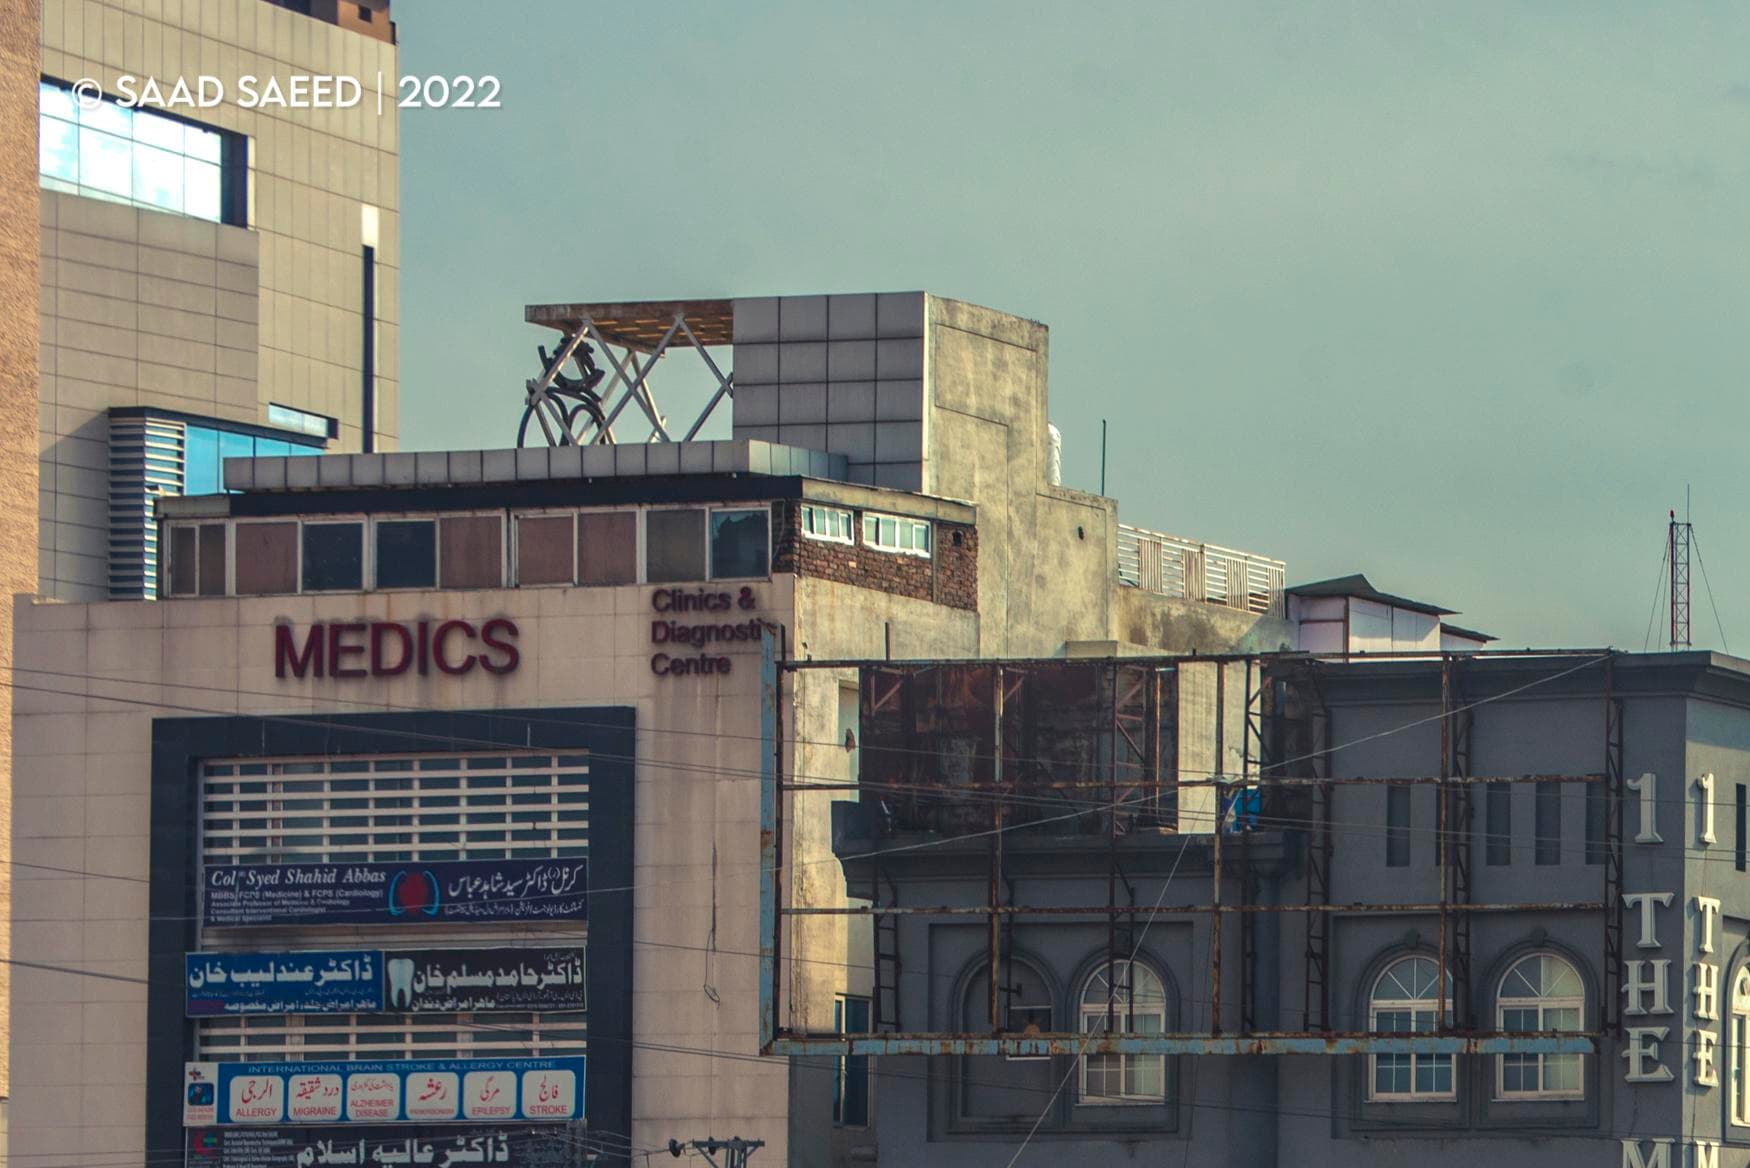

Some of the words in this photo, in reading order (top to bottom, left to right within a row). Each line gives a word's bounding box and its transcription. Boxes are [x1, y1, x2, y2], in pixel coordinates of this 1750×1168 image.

[652, 587, 731, 611] Clinics
[738, 587, 756, 609] &
[652, 618, 763, 648] Diagnosti
[274, 619, 519, 678] MEDICS
[651, 653, 731, 675] Centre
[1627, 773, 1662, 843] 1
[1698, 773, 1717, 845] 1
[211, 870, 236, 887] Col
[247, 869, 281, 891] Syed
[285, 868, 337, 885] Shahid
[343, 868, 387, 883] Abbas
[448, 875, 480, 899] عباس
[312, 890, 334, 898] FCPS
[189, 961, 227, 989] خان
[314, 953, 373, 987] ڈاکٹر
[413, 963, 446, 993] خان
[446, 963, 496, 994] مسلم
[495, 961, 538, 987] حامد
[537, 957, 583, 990] ڈاکٹر
[1622, 892, 1675, 1083] THE
[248, 1064, 341, 1074] INTERNATIONAL
[346, 1063, 383, 1072] BRAIN
[386, 1062, 435, 1071] STROKE
[438, 1062, 446, 1070] &
[449, 1060, 502, 1071] ALLERGY
[507, 1060, 556, 1069] CENTRE
[241, 1078, 272, 1104] الرجی
[539, 1072, 559, 1102] فالج
[235, 1107, 277, 1117] ALLERGY
[293, 1106, 336, 1116] MIGRAINE
[350, 1099, 394, 1108] ALZHEIMER
[529, 1104, 568, 1115] STROKE
[372, 1138, 434, 1168] عالیہ
[439, 1130, 509, 1168] ڈاکٹر
